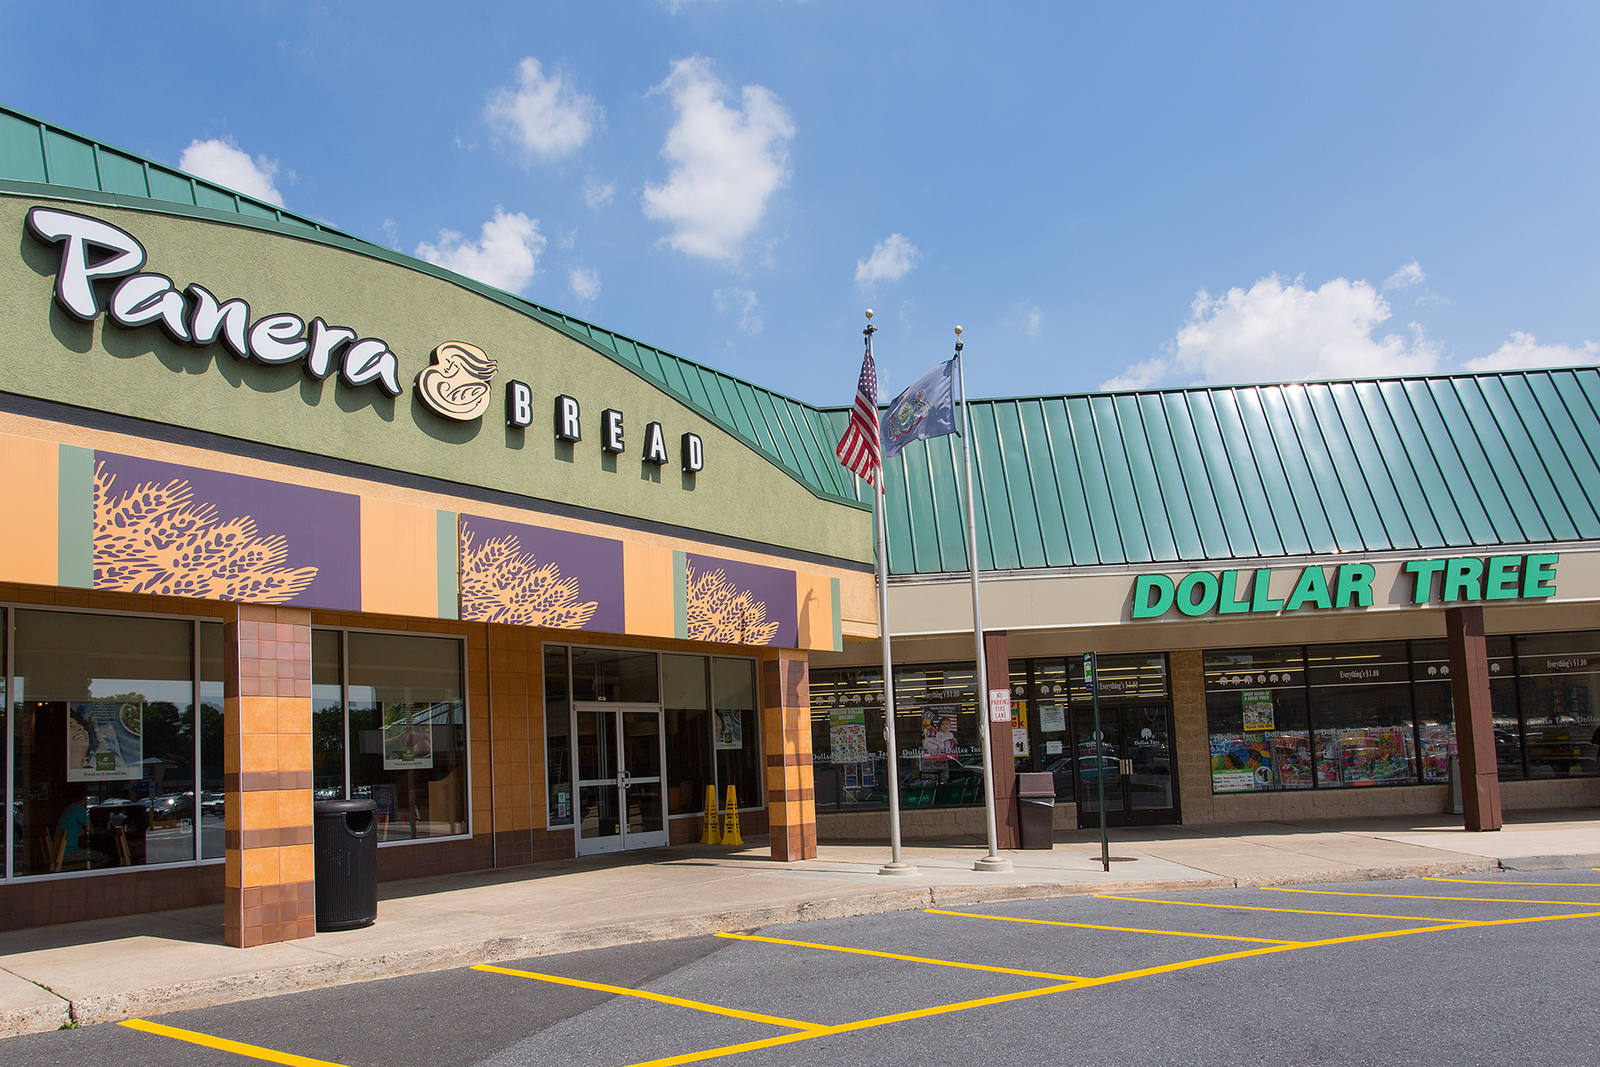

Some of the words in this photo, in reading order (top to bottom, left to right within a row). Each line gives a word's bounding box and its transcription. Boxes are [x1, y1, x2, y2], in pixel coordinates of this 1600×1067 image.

[26, 206, 402, 398] Panera
[507, 380, 703, 472] BREAD
[1132, 562, 1375, 618] DOLLAR
[1403, 553, 1559, 604] TREE
